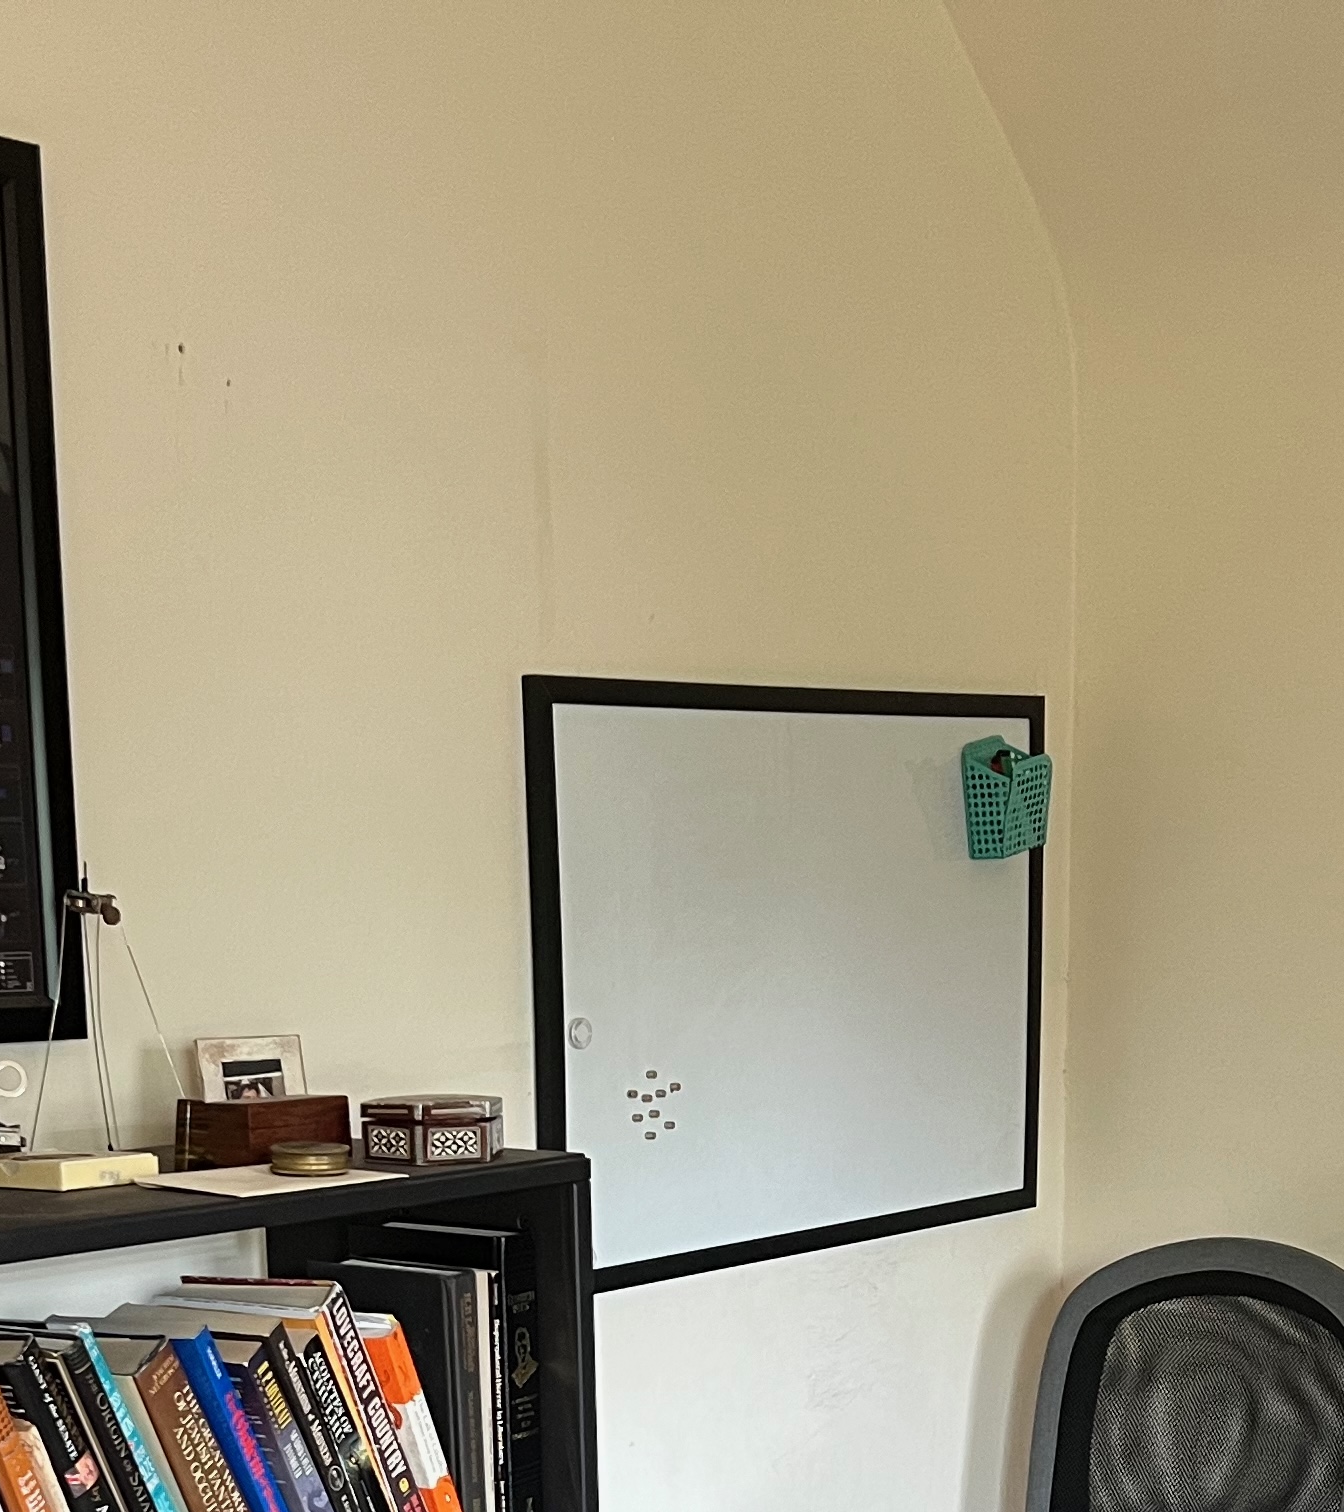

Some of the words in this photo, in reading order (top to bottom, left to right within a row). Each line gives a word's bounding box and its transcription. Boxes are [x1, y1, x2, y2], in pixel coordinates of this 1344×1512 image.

[173, 1391, 188, 1411] OF
[330, 1297, 377, 1398] LOVECRAFT
[366, 1394, 406, 1479] COUNTRY
[173, 1427, 194, 1460] AND
[179, 1414, 213, 1469] JEWISH
[182, 1385, 201, 1417] THE
[195, 1416, 228, 1470] GREAT
